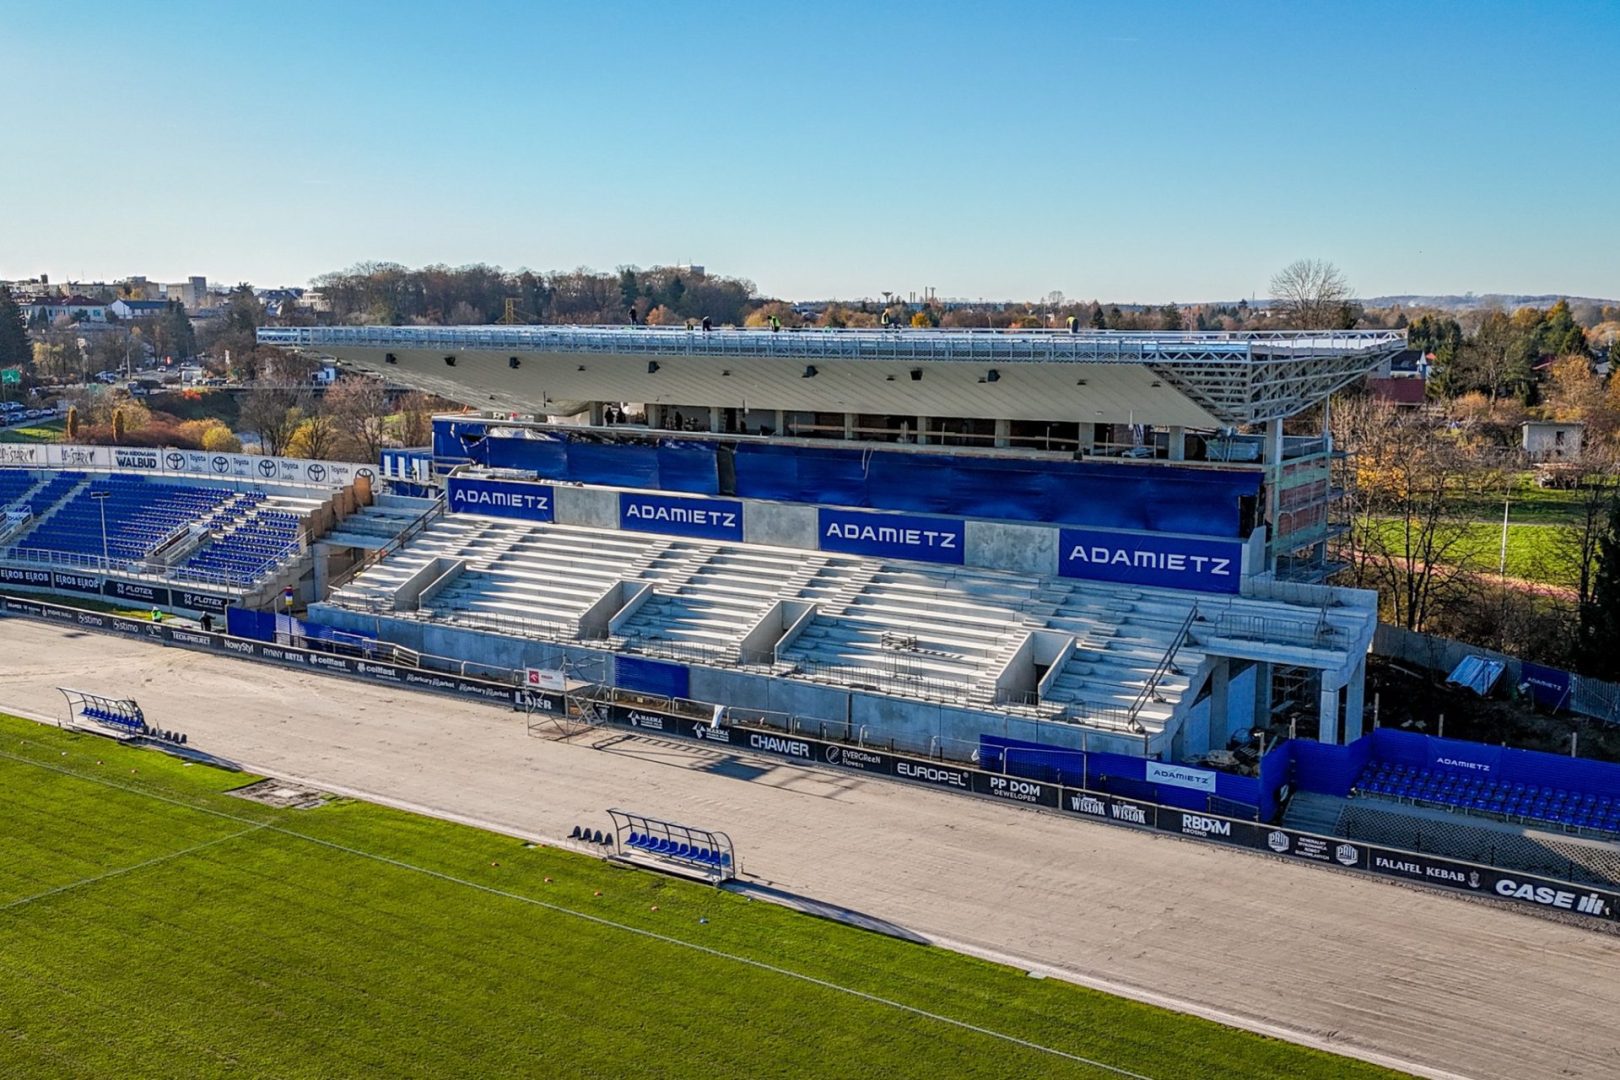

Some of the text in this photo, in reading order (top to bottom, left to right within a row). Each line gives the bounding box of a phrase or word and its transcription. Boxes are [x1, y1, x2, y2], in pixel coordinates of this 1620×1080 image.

[116, 456, 157, 468] WALBUD
[190, 454, 206, 462] Toyota
[233, 458, 249, 466] Toyota
[281, 461, 298, 470] Toyota
[331, 466, 348, 474] Toyota
[454, 489, 548, 510] ADAMIETZ
[626, 504, 736, 527] ADAMIETZ
[826, 522, 956, 548] ADAMIETZ
[1069, 545, 1231, 576] ADAMIETZ
[125, 585, 153, 595] FLOTEX
[193, 596, 223, 606] FLOTEX
[120, 622, 138, 633] stimo
[224, 639, 254, 653] NowyStyl
[641, 715, 663, 724] MARMA
[750, 734, 810, 757] CHAWER
[1436, 757, 1490, 771] ADAMIETZ
[897, 762, 966, 787] EUROPEL
[1153, 769, 1209, 785] ADAMIETZ
[990, 777, 1041, 796] PP DOM
[994, 788, 1037, 802] DEWELOPER
[1376, 857, 1466, 882] FALAFEL KEBAB
[1495, 879, 1576, 909] CASE
